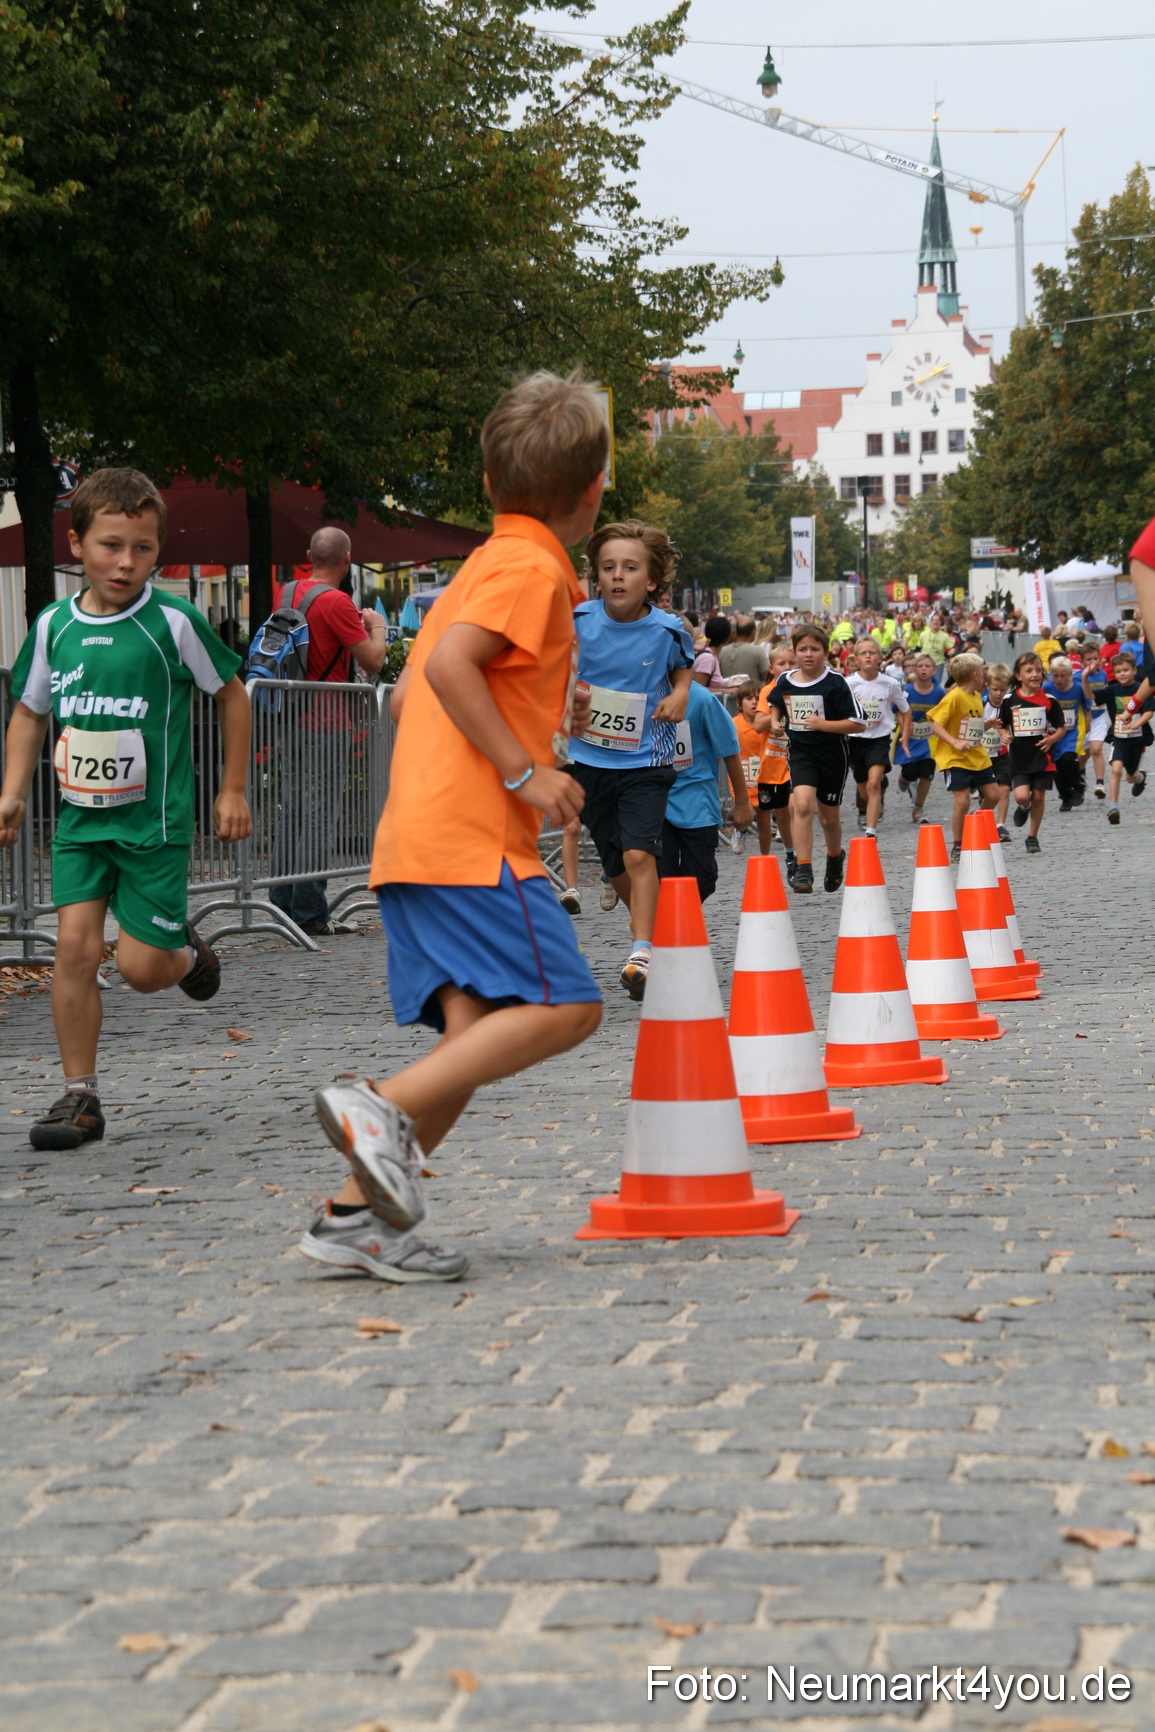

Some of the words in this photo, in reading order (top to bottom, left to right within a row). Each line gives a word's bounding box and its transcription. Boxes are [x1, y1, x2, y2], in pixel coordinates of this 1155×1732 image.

[884, 154, 918, 171] POTAIN
[81, 636, 114, 646] DERBYSTAR
[51, 663, 84, 695] Sport
[795, 701, 815, 709] MARTIN
[591, 709, 637, 732] 7255
[867, 711, 882, 720] 287
[1021, 718, 1043, 727] 7157
[72, 755, 135, 780] 7267
[104, 789, 144, 802] PFLEIDERER
